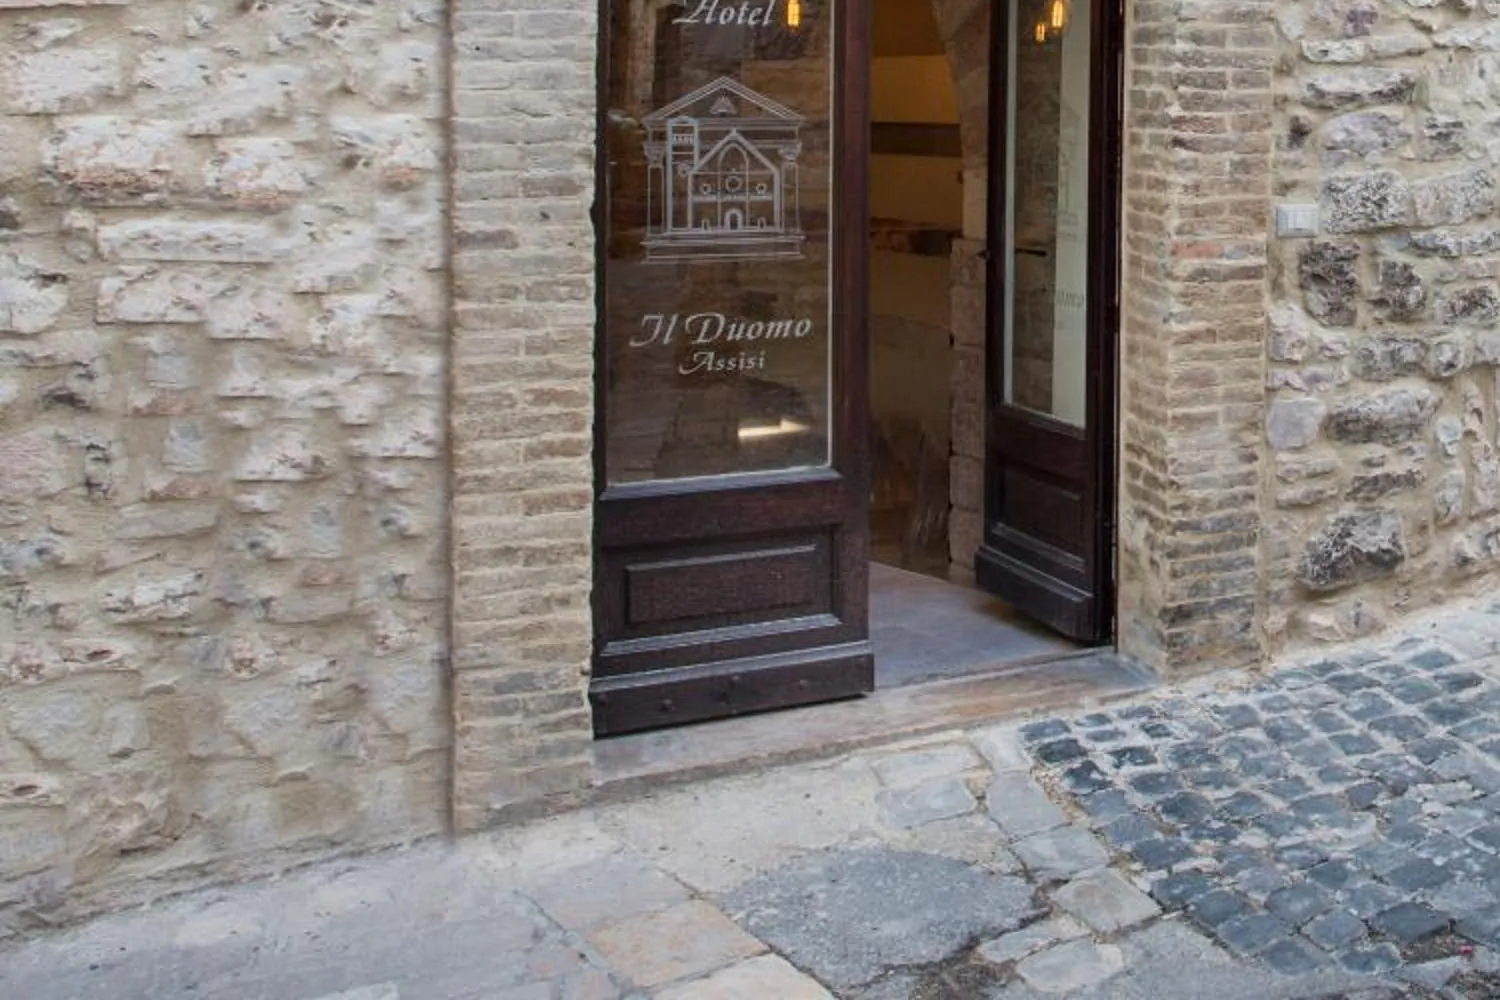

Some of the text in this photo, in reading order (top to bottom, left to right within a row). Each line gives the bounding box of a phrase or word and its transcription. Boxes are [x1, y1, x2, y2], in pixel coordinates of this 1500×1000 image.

[628, 311, 813, 348] Il Duomo
[678, 350, 766, 376] Assisi
